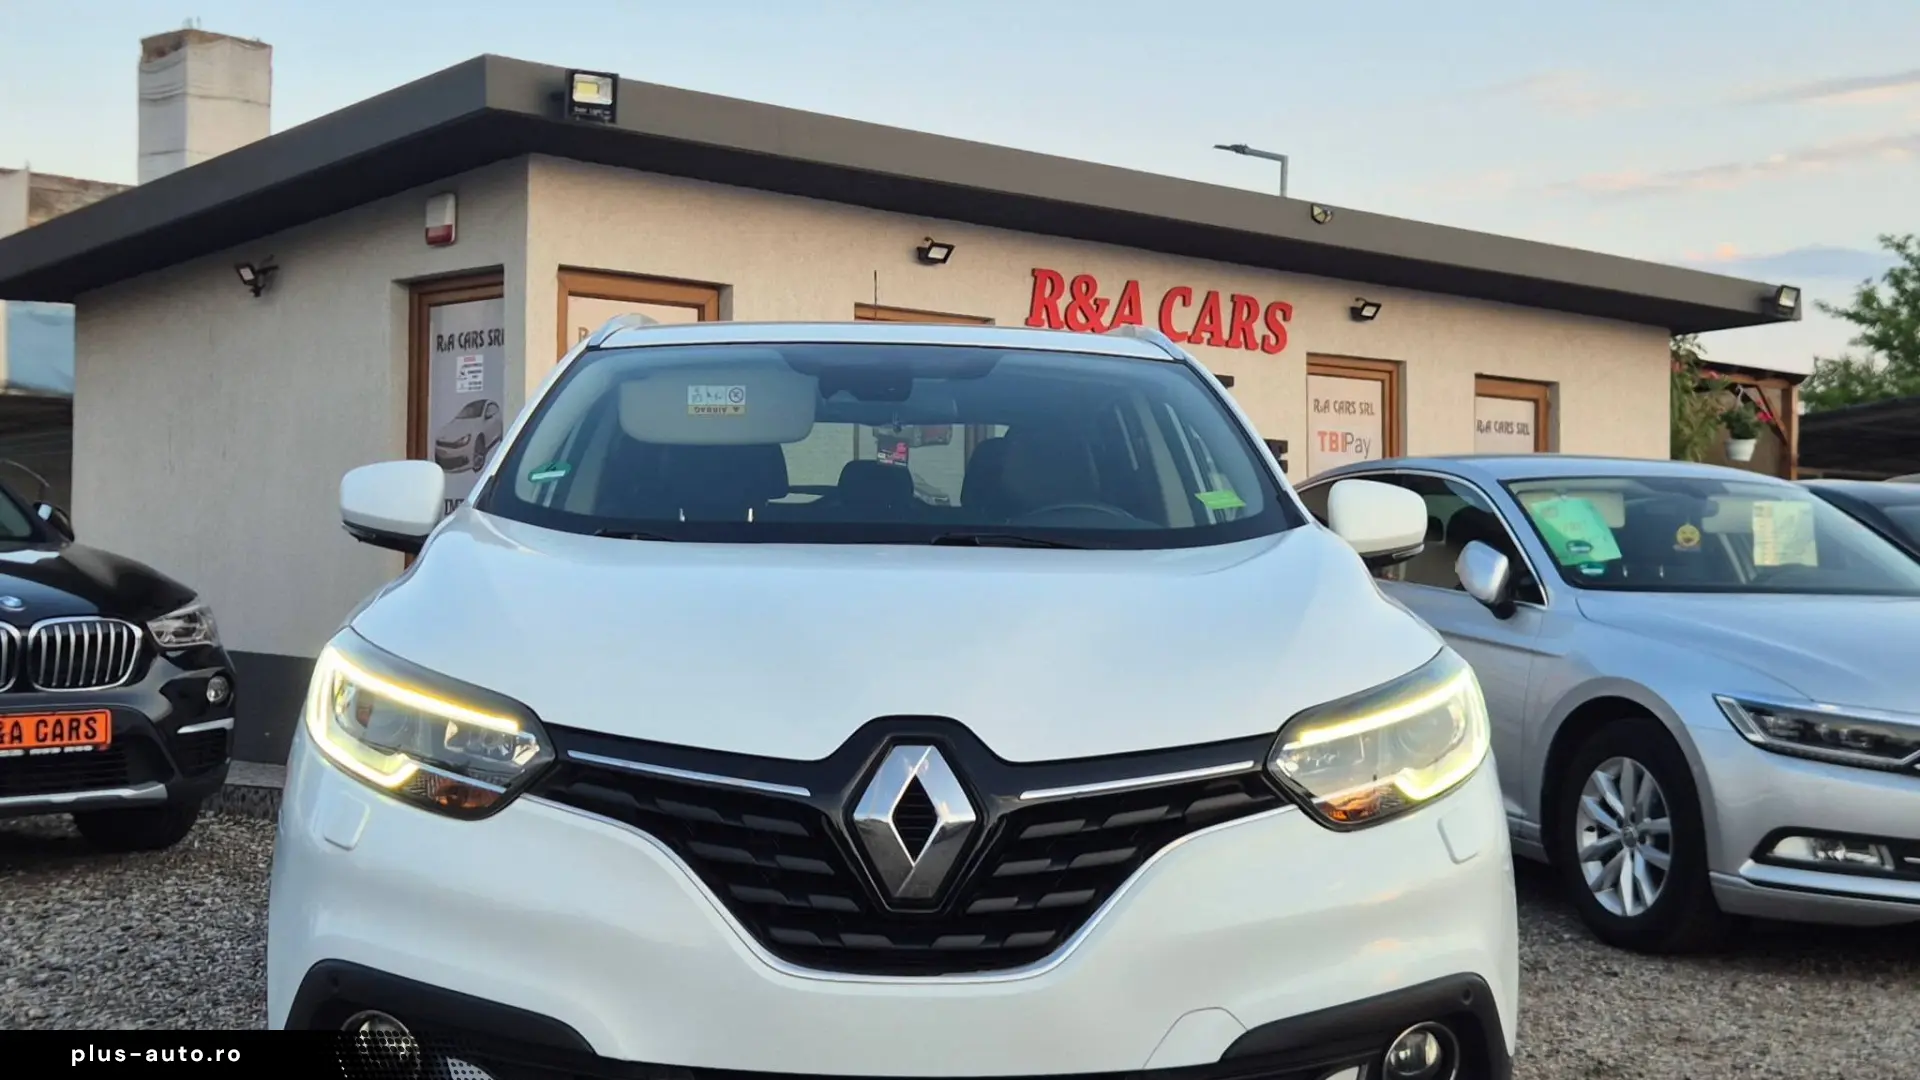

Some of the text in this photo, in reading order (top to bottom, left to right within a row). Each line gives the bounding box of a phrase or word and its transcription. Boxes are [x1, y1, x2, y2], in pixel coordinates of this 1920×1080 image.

[1025, 268, 1293, 354] R&A CARS
[458, 329, 484, 350] CARS
[1333, 399, 1356, 415] CARS
[1494, 420, 1515, 435] CARS
[36, 716, 97, 743] CARS
